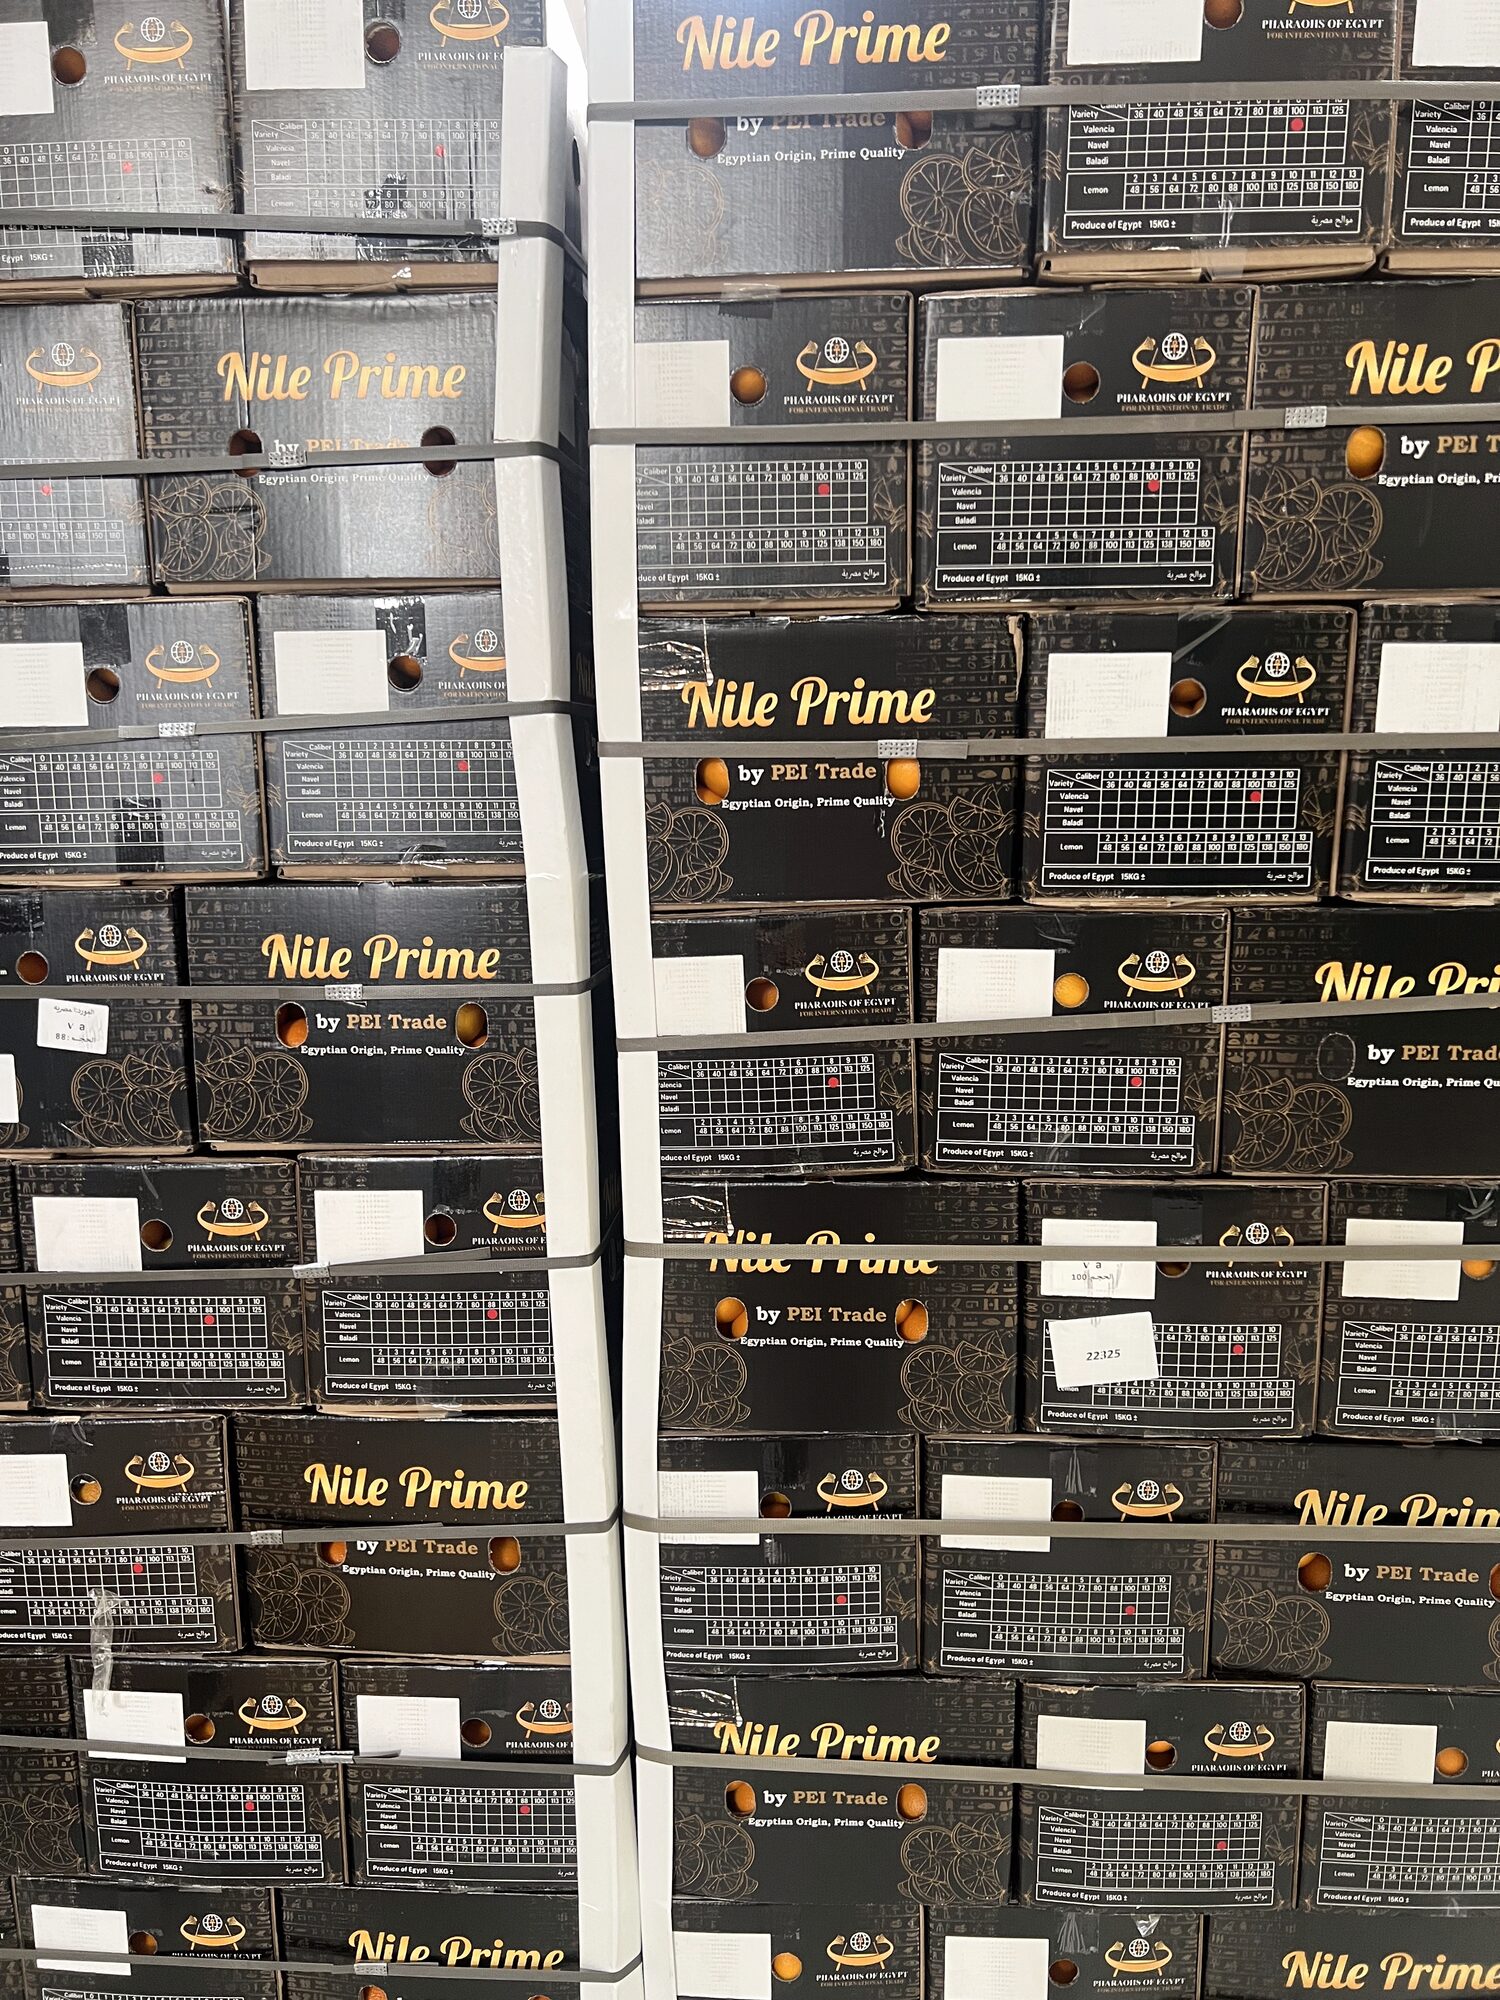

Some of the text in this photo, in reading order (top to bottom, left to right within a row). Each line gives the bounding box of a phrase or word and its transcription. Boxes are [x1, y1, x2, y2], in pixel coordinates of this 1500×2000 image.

[1261, 18, 1385, 30] PHARAOHS OF EGYPT
[677, 10, 950, 70] Nile Prime
[1072, 110, 1098, 120] Variety
[1134, 106, 1345, 119] 36 40 48 56 64 72 80 88 100 113 125
[736, 116, 763, 135] by
[1082, 124, 1116, 134] Valencia
[1087, 140, 1109, 150] Navel
[717, 147, 906, 165] Egyptian Origin, Prime Quality
[1085, 156, 1109, 166] Baladi
[1083, 185, 1109, 195] Lemon
[1072, 220, 1169, 230] Produce of Egypt 15KG
[1311, 216, 1353, 227] موالح مصرية
[1346, 341, 1452, 394] Nile
[217, 348, 465, 405] Nile Prime
[783, 394, 895, 406] PHARAOHS OF EGYPT
[1401, 435, 1478, 459] by PEI
[259, 470, 429, 488] Egyptian Origin, Prime Quality
[1378, 473, 1480, 487] Egyptian Origin,
[190, 692, 203, 700] OF
[682, 677, 935, 728] Nile Prime
[1221, 707, 1330, 717] PHARAOHS OF EGYPT
[738, 763, 876, 785] by PEI Trade
[722, 796, 895, 810] Egyptian Origin, Prime Quality
[262, 934, 500, 979] Nile Prime
[65, 972, 165, 983] PHARAOHS OF EGYPT
[1315, 962, 1416, 1002] Nile
[794, 998, 896, 1010] PHARAOHS OF EGYPT
[316, 1014, 446, 1033] by PEI Trade
[300, 1045, 466, 1057] Egyptian Origin, Prime Quality
[1368, 1044, 1440, 1064] by PEI
[1347, 1077, 1481, 1089] Egyptian Origin, Prime
[187, 1244, 287, 1252] PHARAOHS OF EGYPT
[1205, 1270, 1308, 1279] PHARAOHS OF EGYPT
[46, 1297, 89, 1313] Variety Caliber
[55, 1314, 82, 1322] Valencia
[756, 1306, 886, 1325] by PEI Trade
[60, 1326, 79, 1334] Navel
[60, 1337, 80, 1345] Baladi
[740, 1337, 904, 1349] Egyptian Origin, Prime Quality
[1086, 1349, 1120, 1360] 22325
[61, 1358, 83, 1366] Lemon
[55, 1384, 80, 1393] Produce
[92, 1384, 112, 1394] Egypt
[117, 1384, 134, 1392] 15KG
[304, 1464, 528, 1509] Nile Prime
[1294, 1488, 1388, 1526] Nile
[357, 1539, 478, 1556] by PEI Trade
[341, 1564, 496, 1581] Egyptian Origin, Prime Quality
[1344, 1564, 1479, 1582] by PEI Trade
[1325, 1591, 1496, 1609] Egyptian Origin, Prime Quality
[229, 1737, 278, 1745] PHARAOHS
[292, 1737, 322, 1745] EGYPT
[714, 1721, 940, 1762] Nile Prime
[763, 1790, 889, 1807] by PEI Trade
[748, 1817, 905, 1830] Egyptian Origin, Prime Quality
[349, 1930, 564, 1970] Nile Prime
[815, 1971, 908, 1982] PHARAOHS OF EGYPT
[1282, 1951, 1500, 1990] Nile Prime
